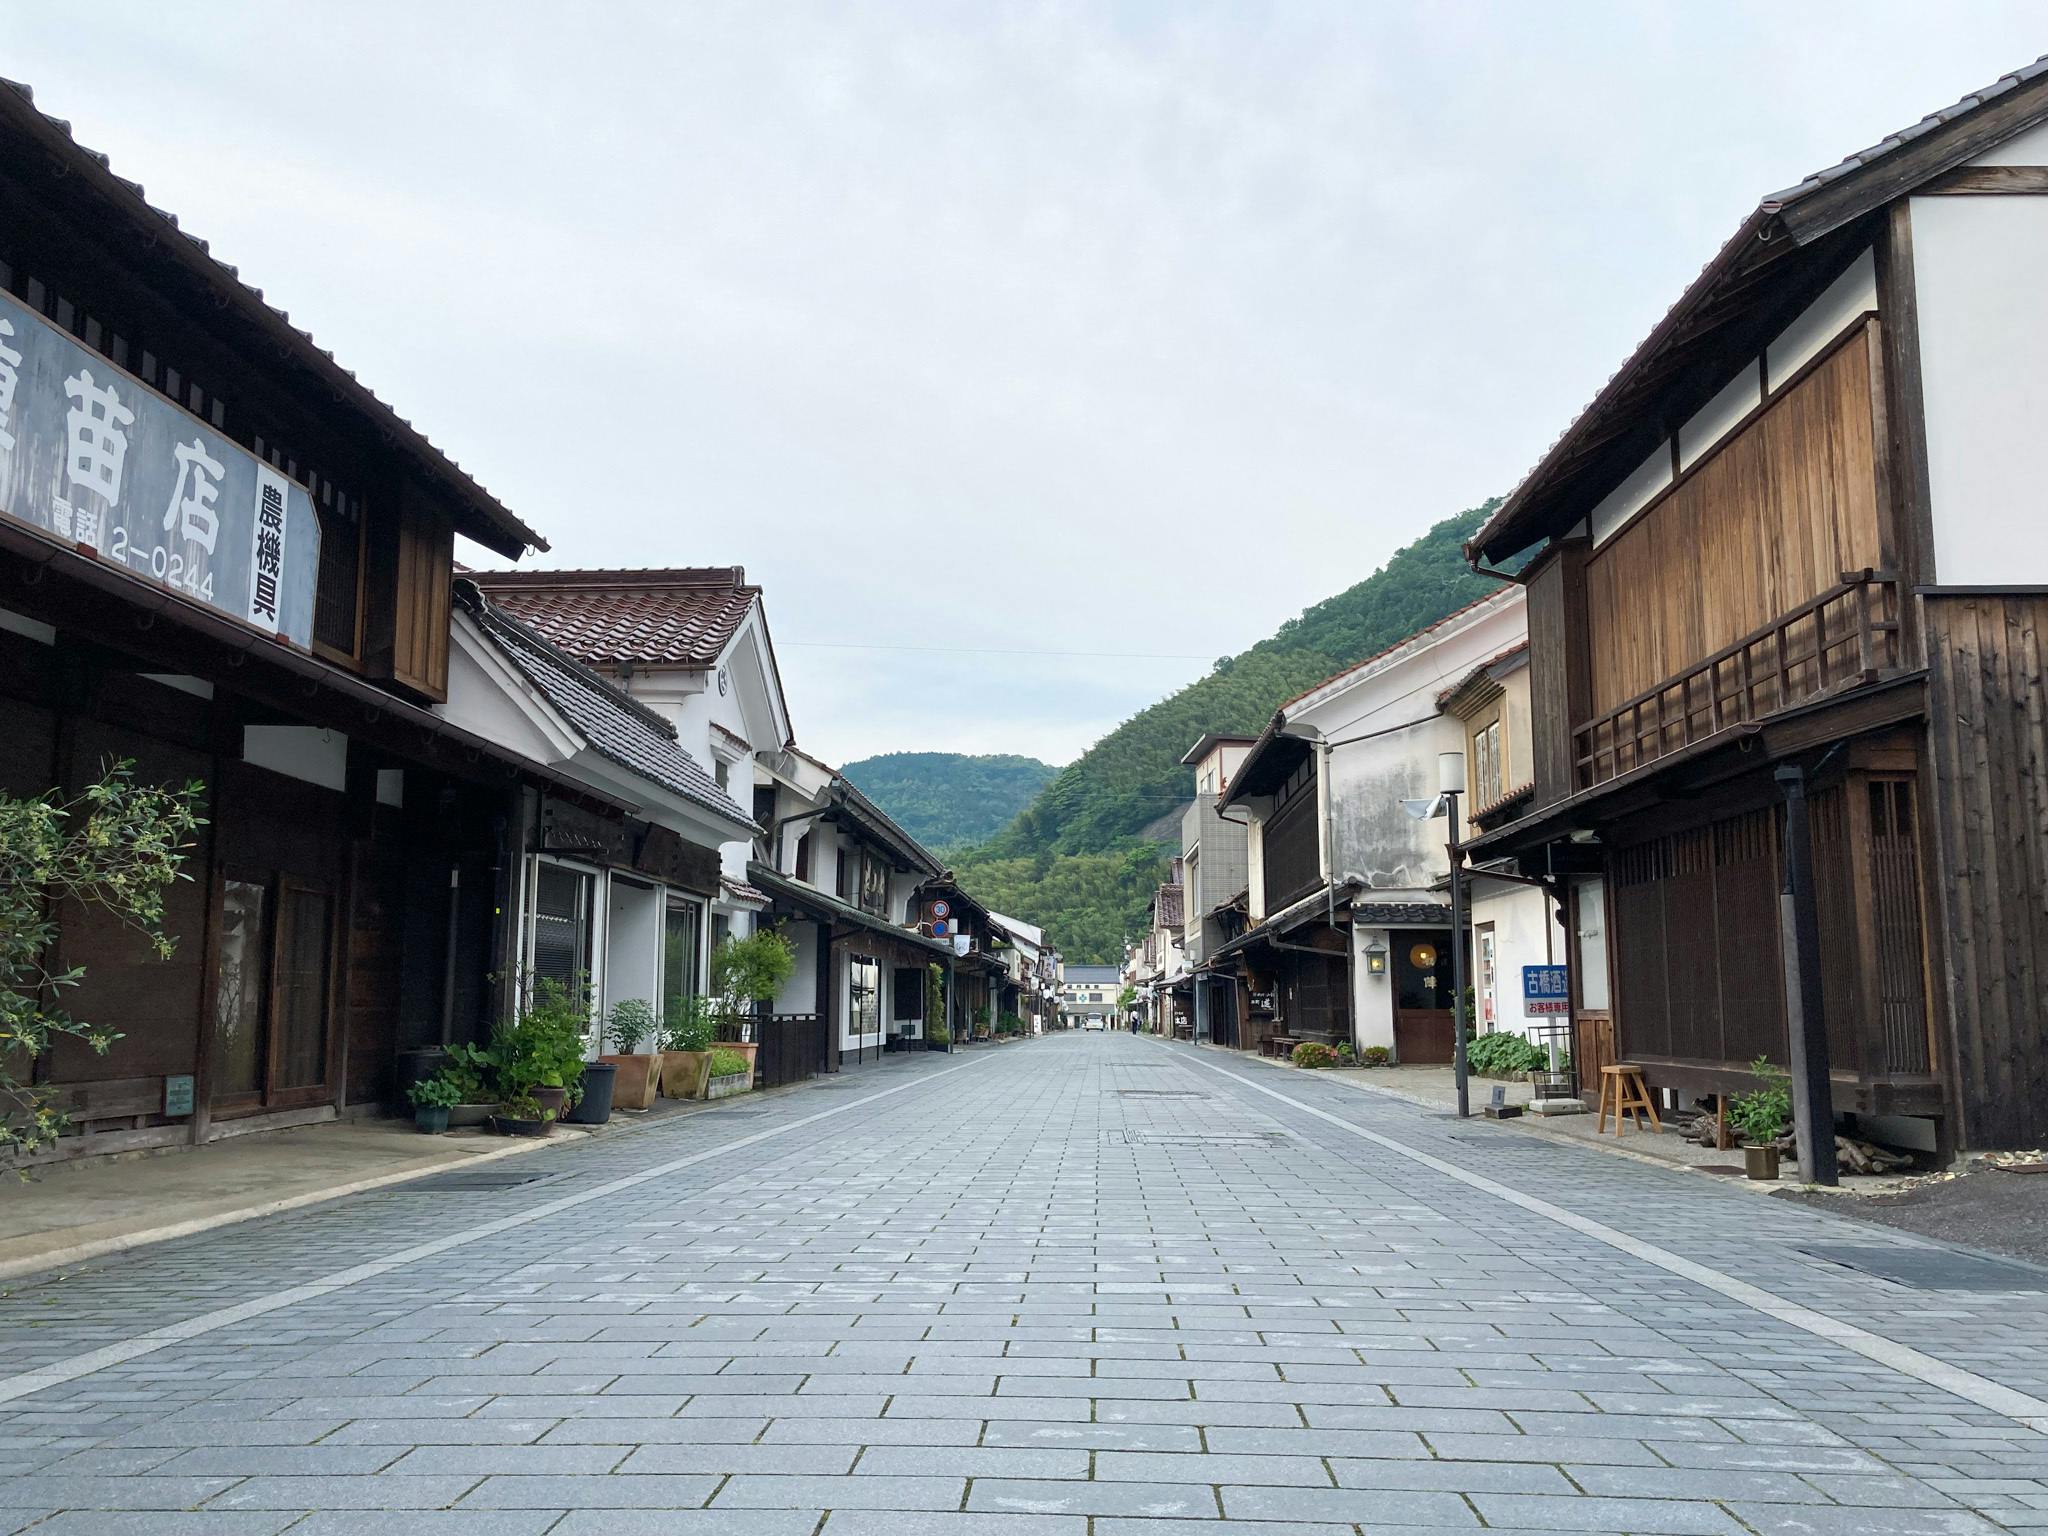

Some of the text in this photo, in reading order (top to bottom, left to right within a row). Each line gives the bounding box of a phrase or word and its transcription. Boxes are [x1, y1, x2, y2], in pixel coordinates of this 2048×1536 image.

[0, 319, 226, 556] 苗店
[53, 497, 214, 601] 電話 2-0244
[253, 483, 283, 623] 農機具
